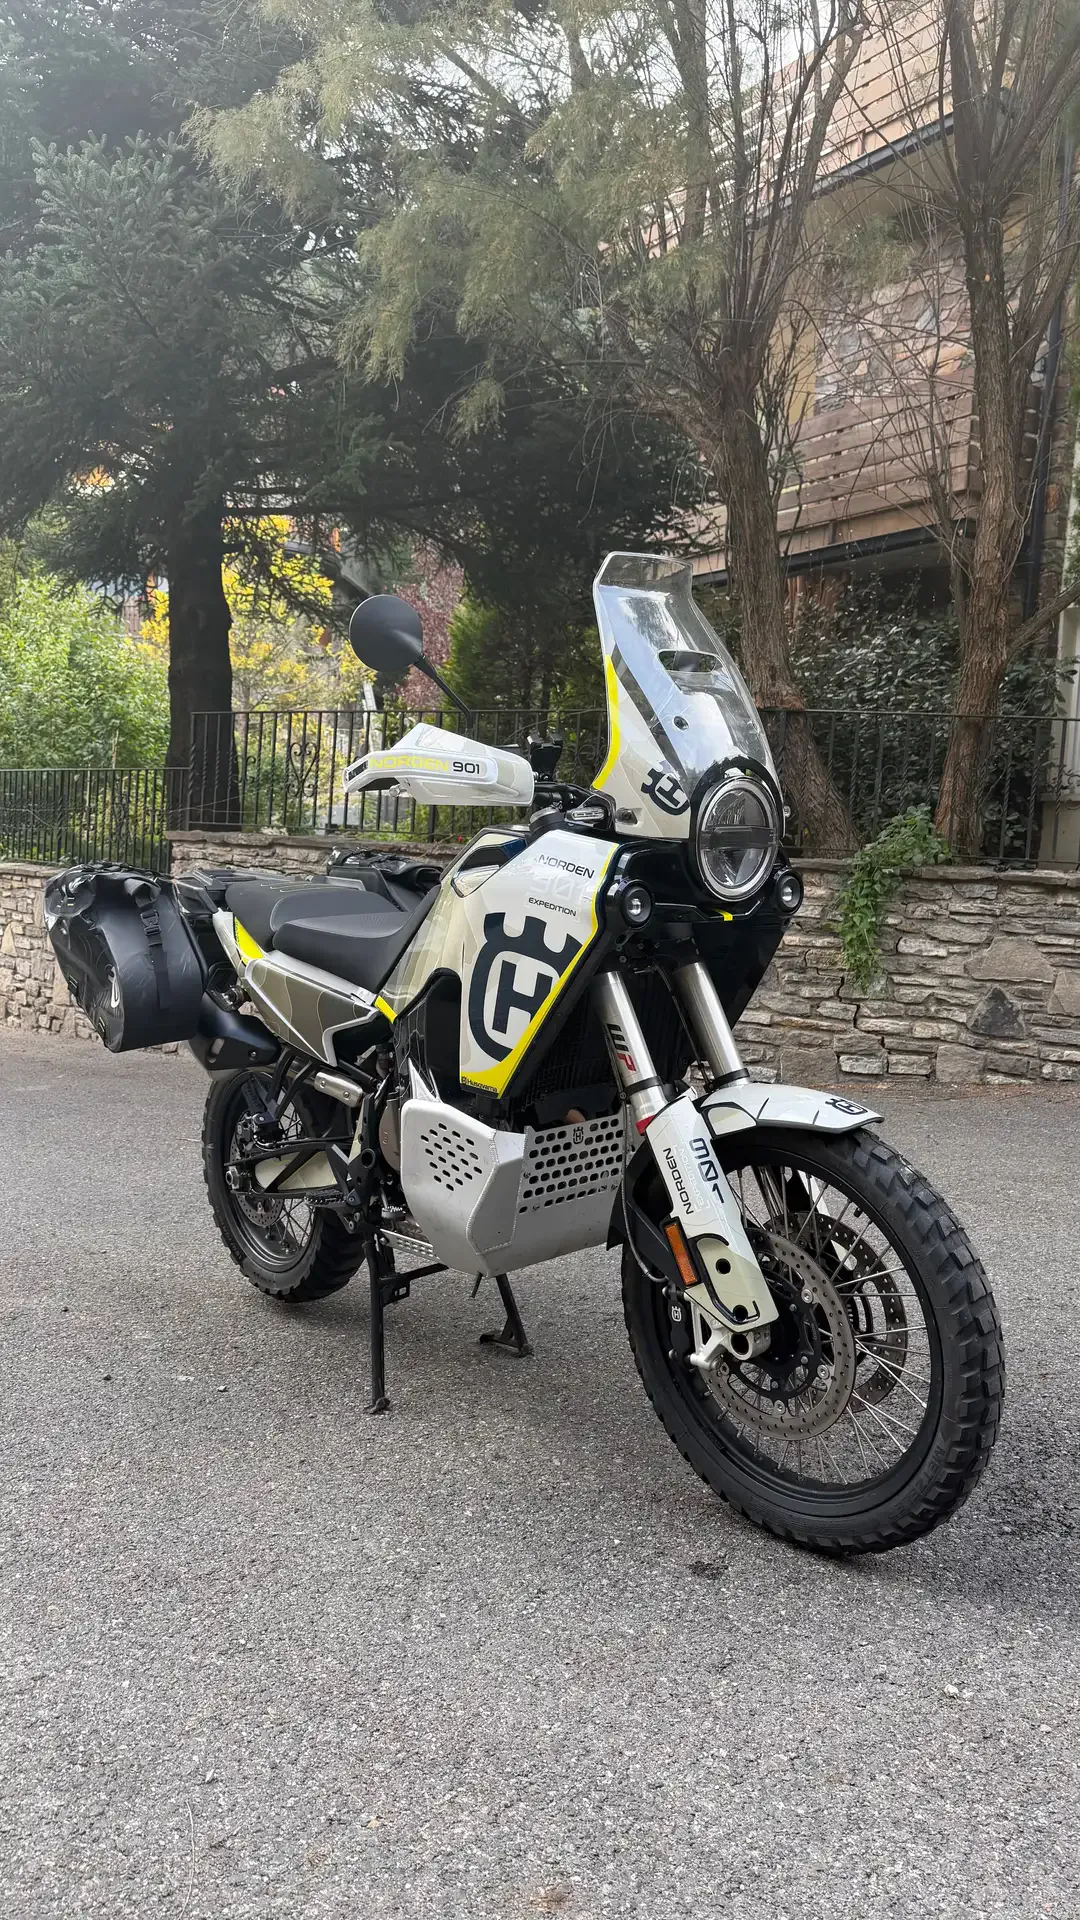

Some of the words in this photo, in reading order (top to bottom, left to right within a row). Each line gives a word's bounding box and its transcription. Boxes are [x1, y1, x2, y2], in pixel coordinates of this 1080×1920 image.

[369, 755, 449, 773] NORDEN
[453, 761, 480, 775] 901
[538, 854, 595, 879] NORDEN
[528, 897, 577, 917] EXPEDITION
[663, 1147, 695, 1215] NORDEN
[689, 1137, 725, 1204] 901
